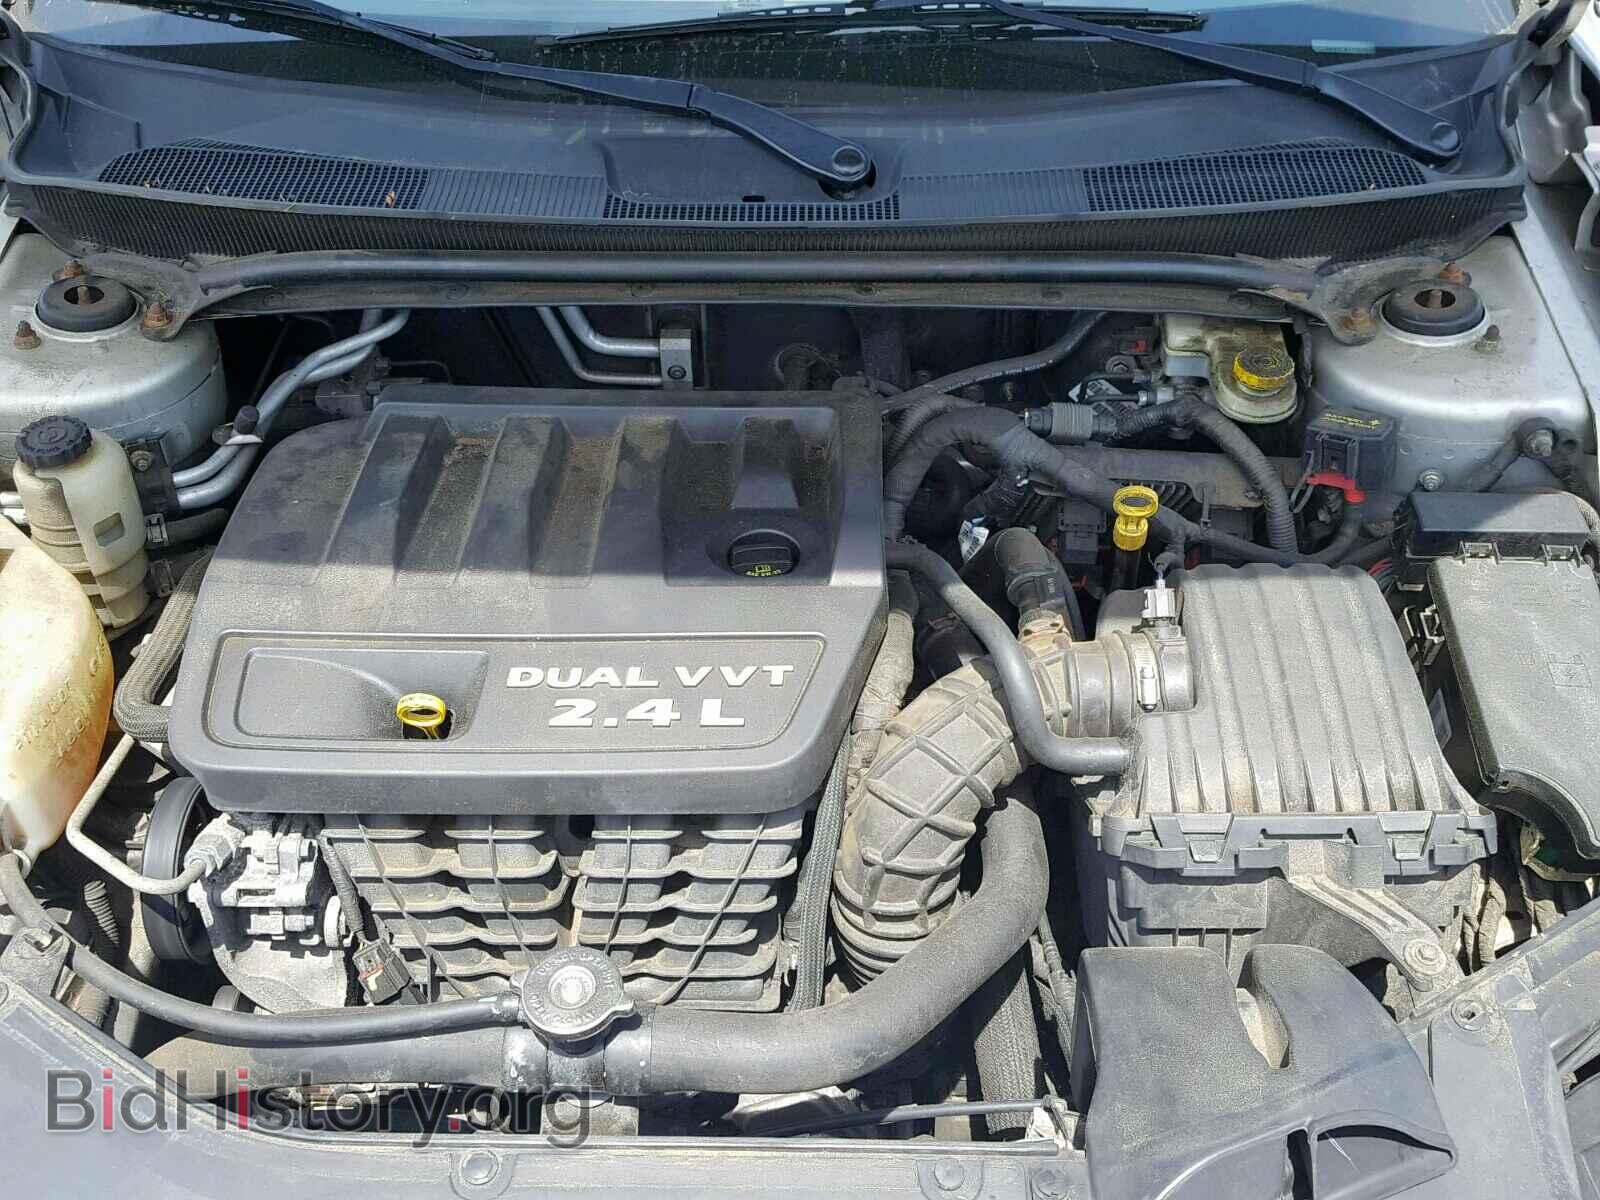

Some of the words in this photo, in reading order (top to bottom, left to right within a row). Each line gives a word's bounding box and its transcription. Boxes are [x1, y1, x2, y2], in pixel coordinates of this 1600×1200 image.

[506, 666, 660, 689] DUAL
[673, 665, 794, 687] VVT
[548, 698, 682, 728] 2.4
[699, 698, 746, 727] L
